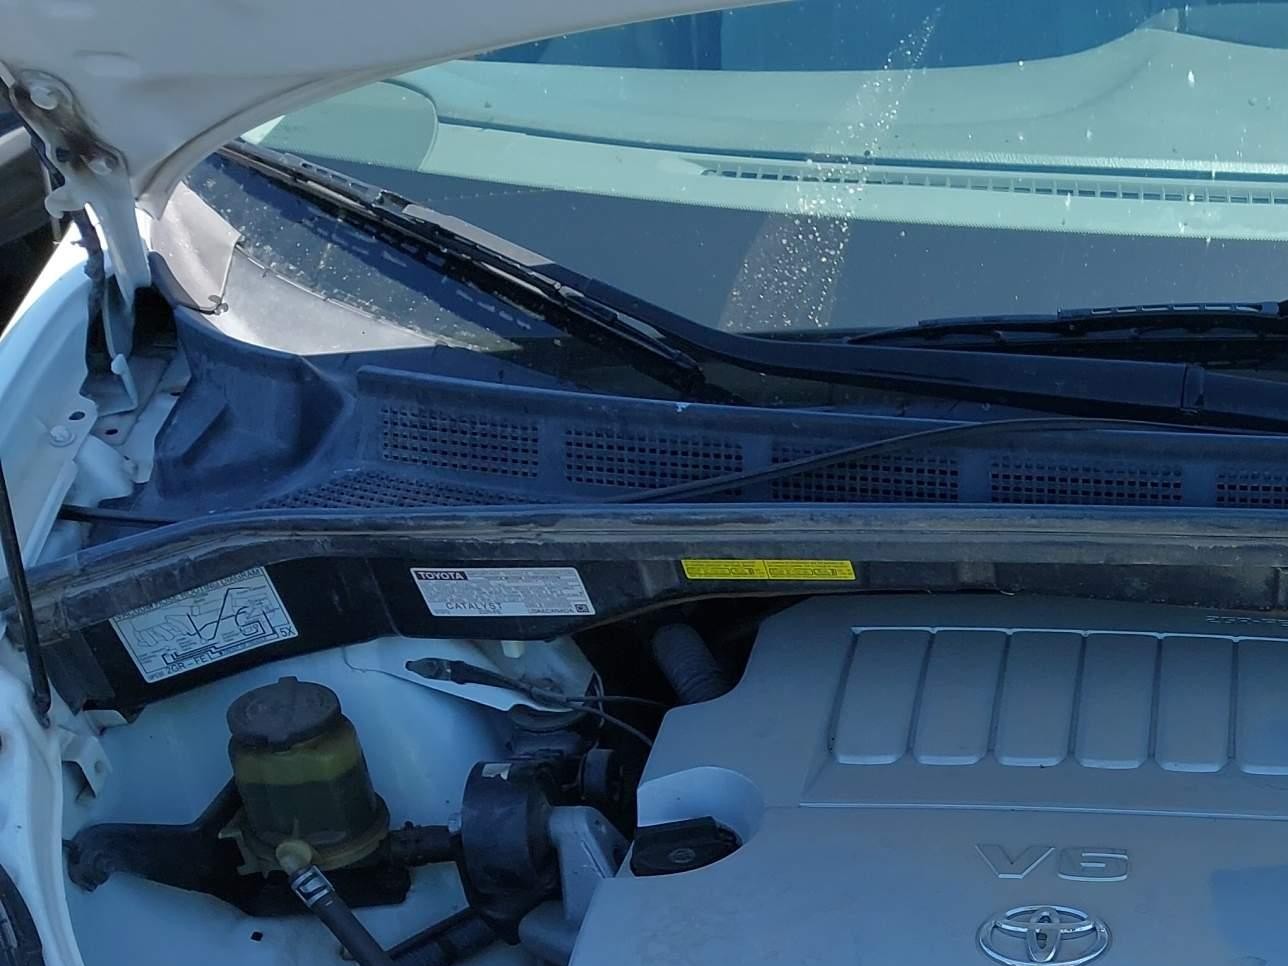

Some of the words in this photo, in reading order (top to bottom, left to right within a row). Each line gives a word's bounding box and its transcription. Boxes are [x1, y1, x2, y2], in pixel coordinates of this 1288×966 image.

[417, 571, 464, 580] TOYOTA
[445, 601, 504, 611] CATALYST
[280, 625, 296, 638] 5X
[975, 843, 1130, 882] V6
